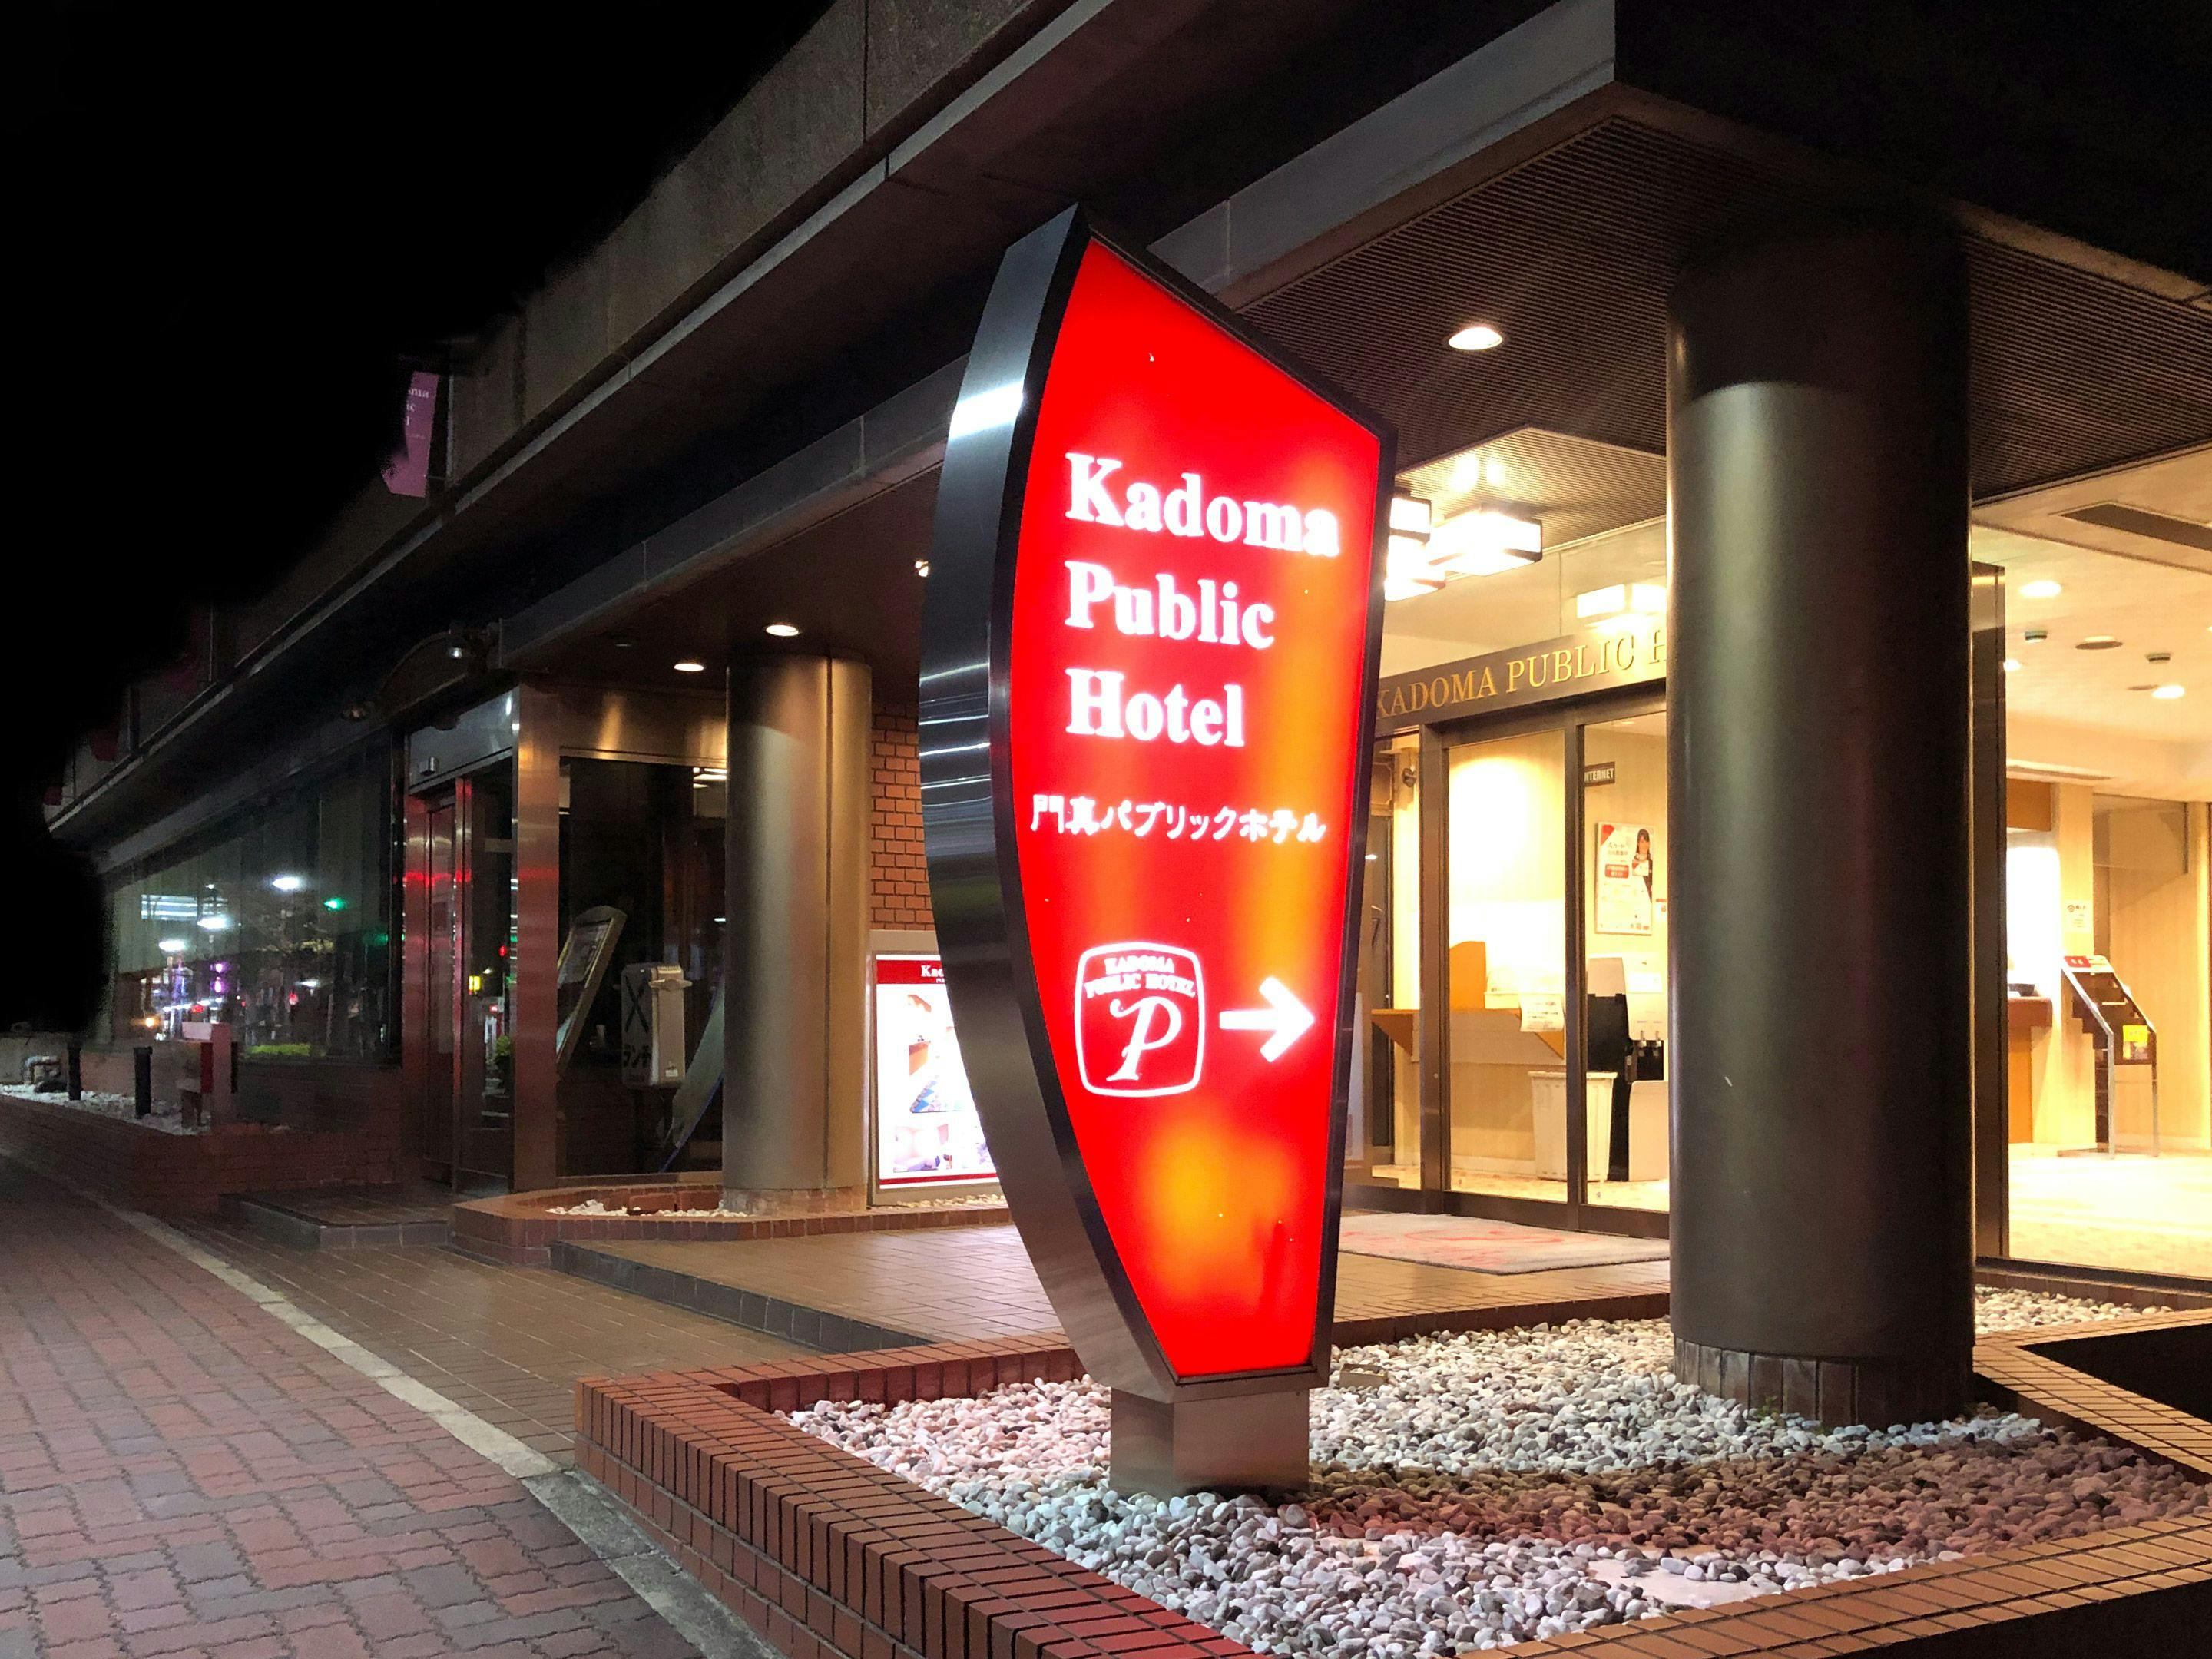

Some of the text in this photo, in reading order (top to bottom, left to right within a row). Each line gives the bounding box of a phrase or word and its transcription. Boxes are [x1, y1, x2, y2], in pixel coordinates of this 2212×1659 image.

[1065, 452, 1341, 558] Kadoma
[1065, 561, 1275, 650] Public
[1506, 634, 1634, 694] PUBLIC
[1065, 668, 1245, 747] Hotel
[1031, 794, 1327, 844] 門真パブリックホテル
[1109, 996, 1181, 1081] P
